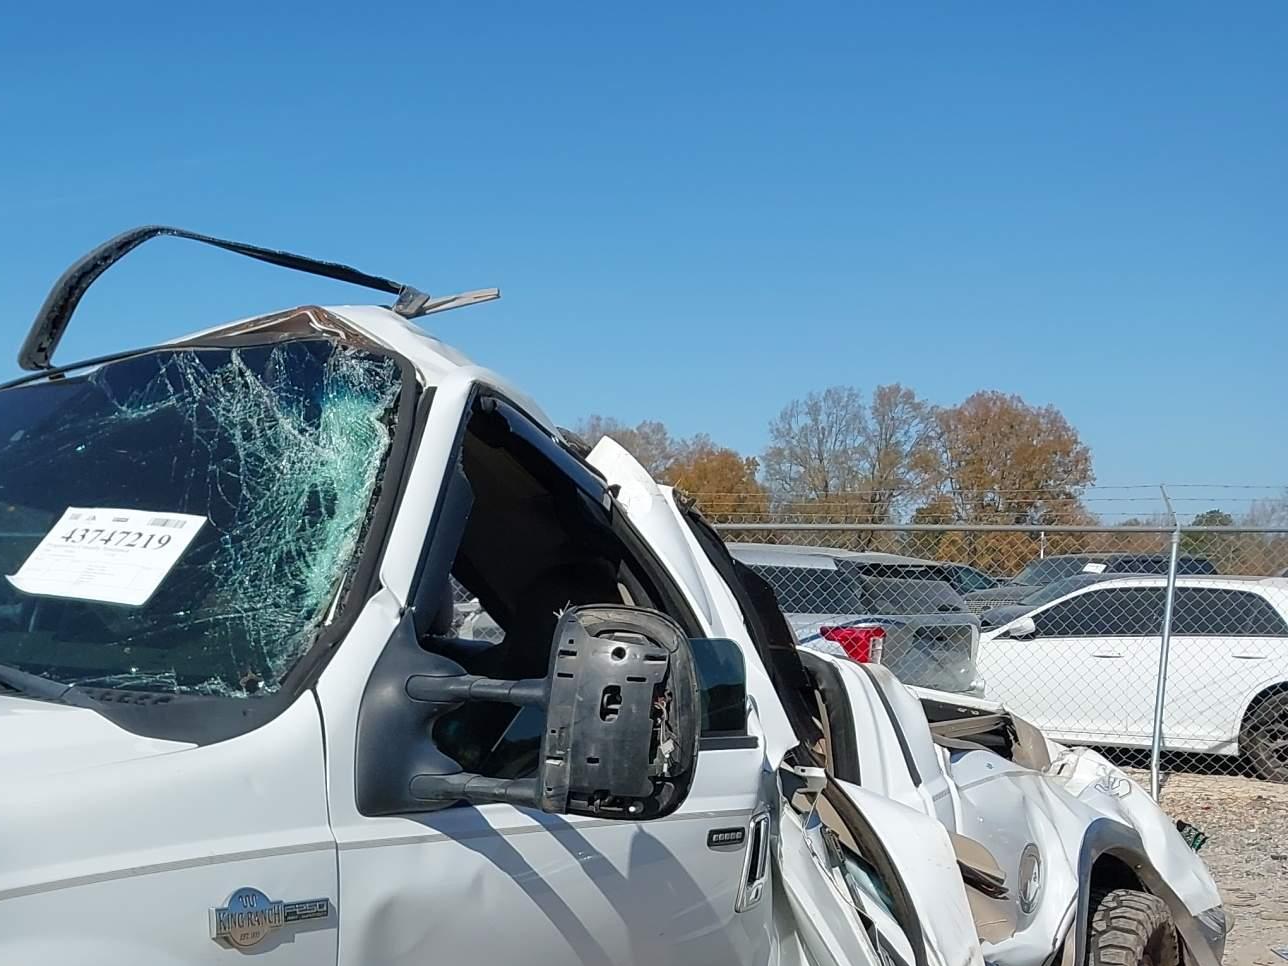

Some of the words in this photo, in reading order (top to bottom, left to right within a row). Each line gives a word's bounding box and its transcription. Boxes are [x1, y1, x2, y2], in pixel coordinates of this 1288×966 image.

[61, 527, 172, 551] 43747219
[217, 911, 245, 931] KING
[246, 904, 281, 928] RANCH
